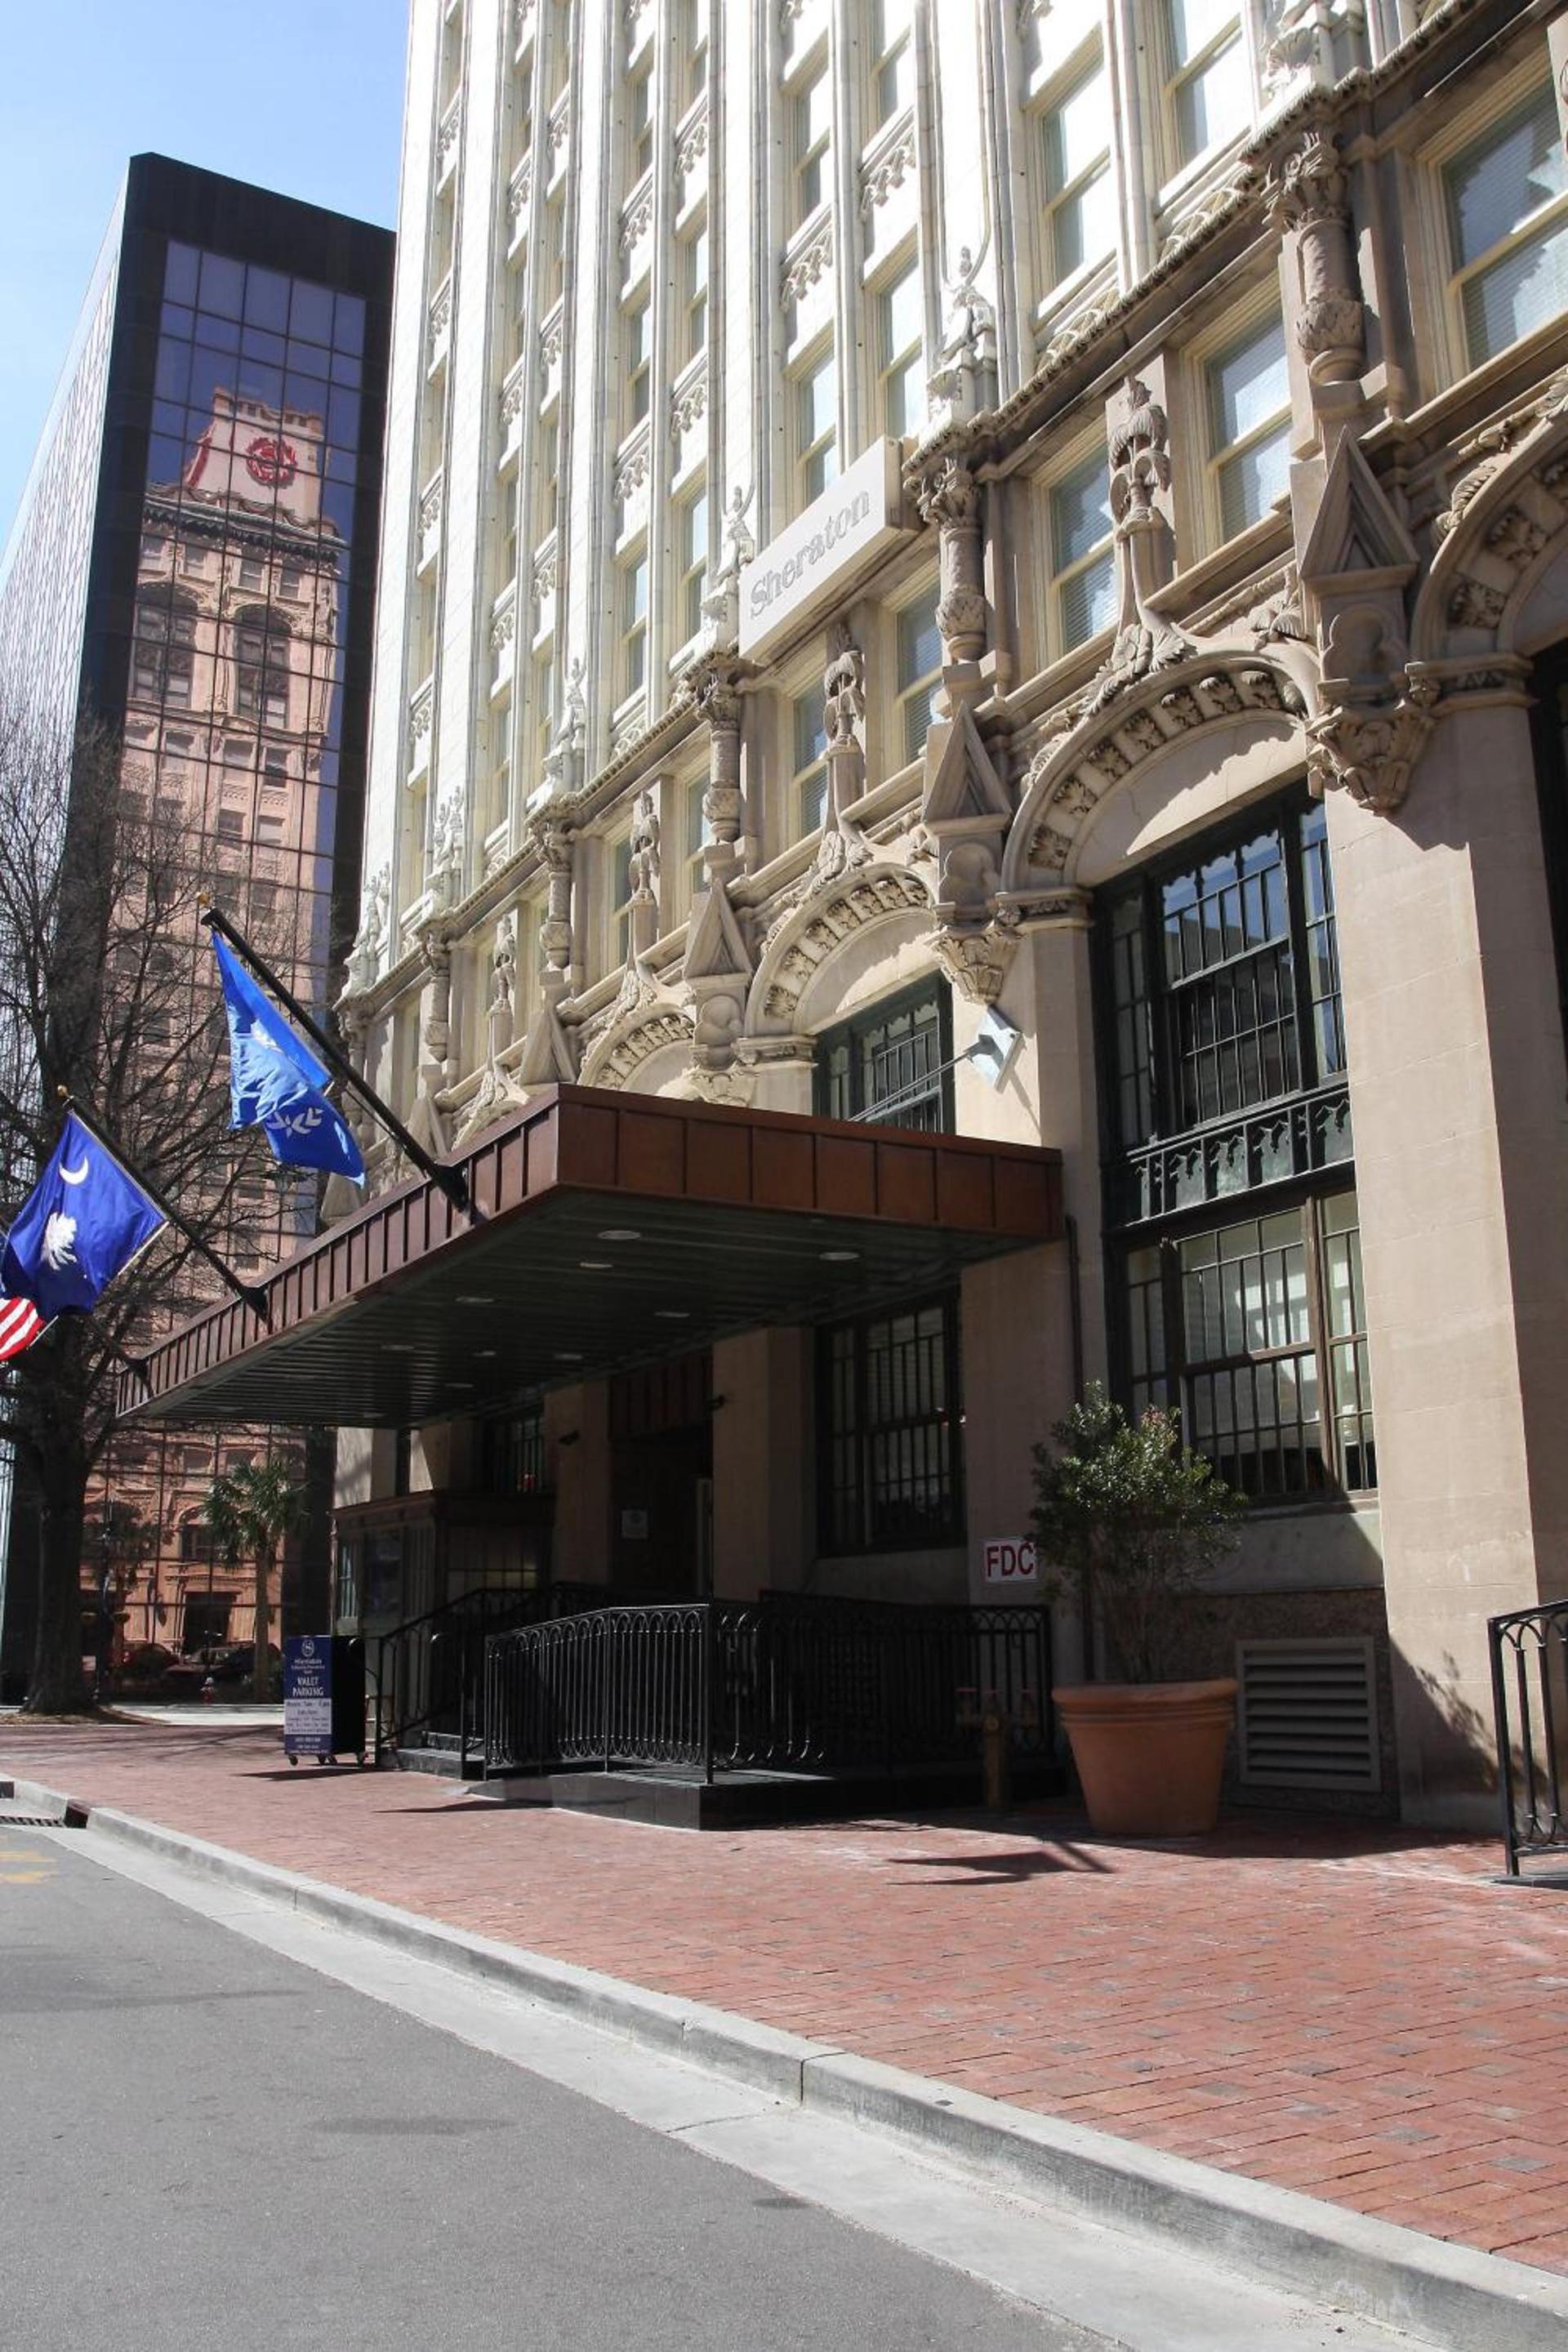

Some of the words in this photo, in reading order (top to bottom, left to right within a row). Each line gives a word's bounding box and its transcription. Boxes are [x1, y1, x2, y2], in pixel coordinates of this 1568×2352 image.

[751, 490, 870, 619] Sheraton
[987, 1542, 1034, 1577] FDC
[292, 1686, 323, 1696] PARKING
[297, 1677, 318, 1686] VALET
